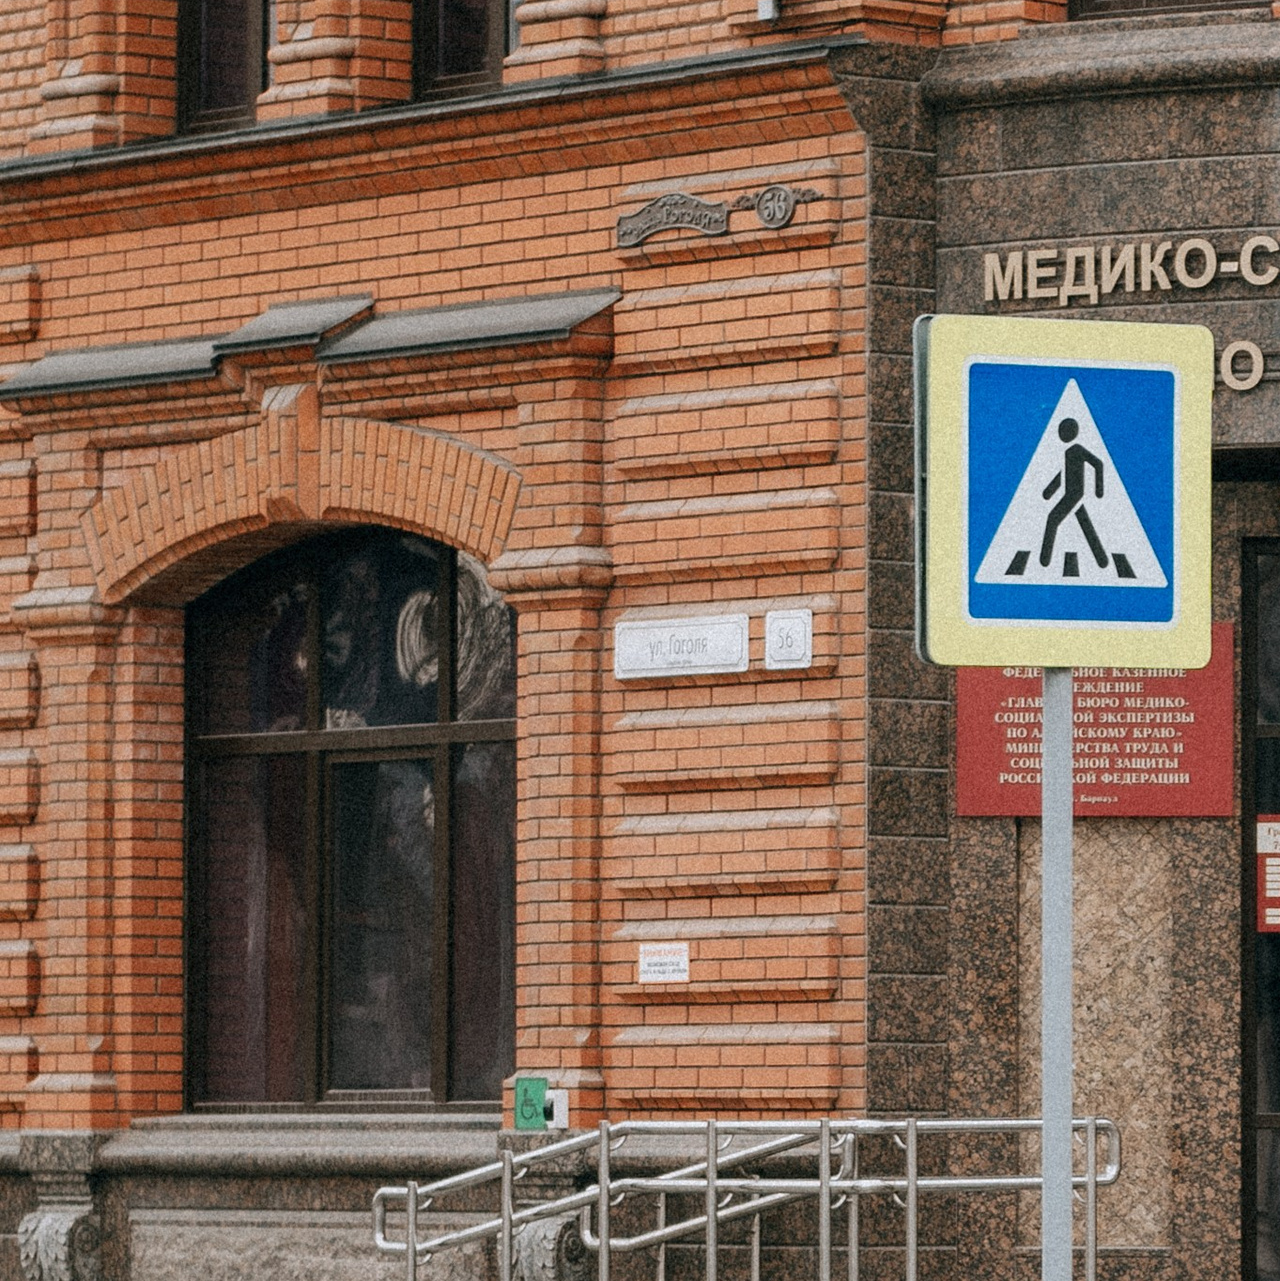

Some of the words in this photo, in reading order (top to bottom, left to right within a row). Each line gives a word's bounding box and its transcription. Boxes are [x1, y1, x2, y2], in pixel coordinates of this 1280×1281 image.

[763, 191, 786, 220] 56
[1220, 341, 1264, 391] О
[669, 634, 708, 655] Гоголя
[778, 627, 794, 649] 56
[1003, 667, 1107, 679] ФЕДЕЬНОЕ
[1112, 668, 1187, 678] КАЗЕННОЕ
[1073, 681, 1145, 693] ЕЖДЕНИЕ
[1077, 697, 1120, 708] БЮРО
[1124, 697, 1190, 709] МЕДИКО-
[994, 710, 1094, 723] СОЦИАОЙ
[1099, 711, 1195, 723] ЭКСПЕРТИЗЫ
[1006, 727, 1028, 738] ПО
[1031, 726, 1128, 738] АСКОМУ
[1005, 742, 1120, 754] МИНРСТВА
[1124, 742, 1169, 754] ТРУДА
[1173, 742, 1184, 753] И
[1010, 756, 1110, 769] СОЦЬНОЙ
[1114, 757, 1179, 769] ЗАЩИТЫ
[999, 771, 1096, 784] РОССОЙ
[1101, 772, 1190, 785] ФЕДЕРАЦИИ
